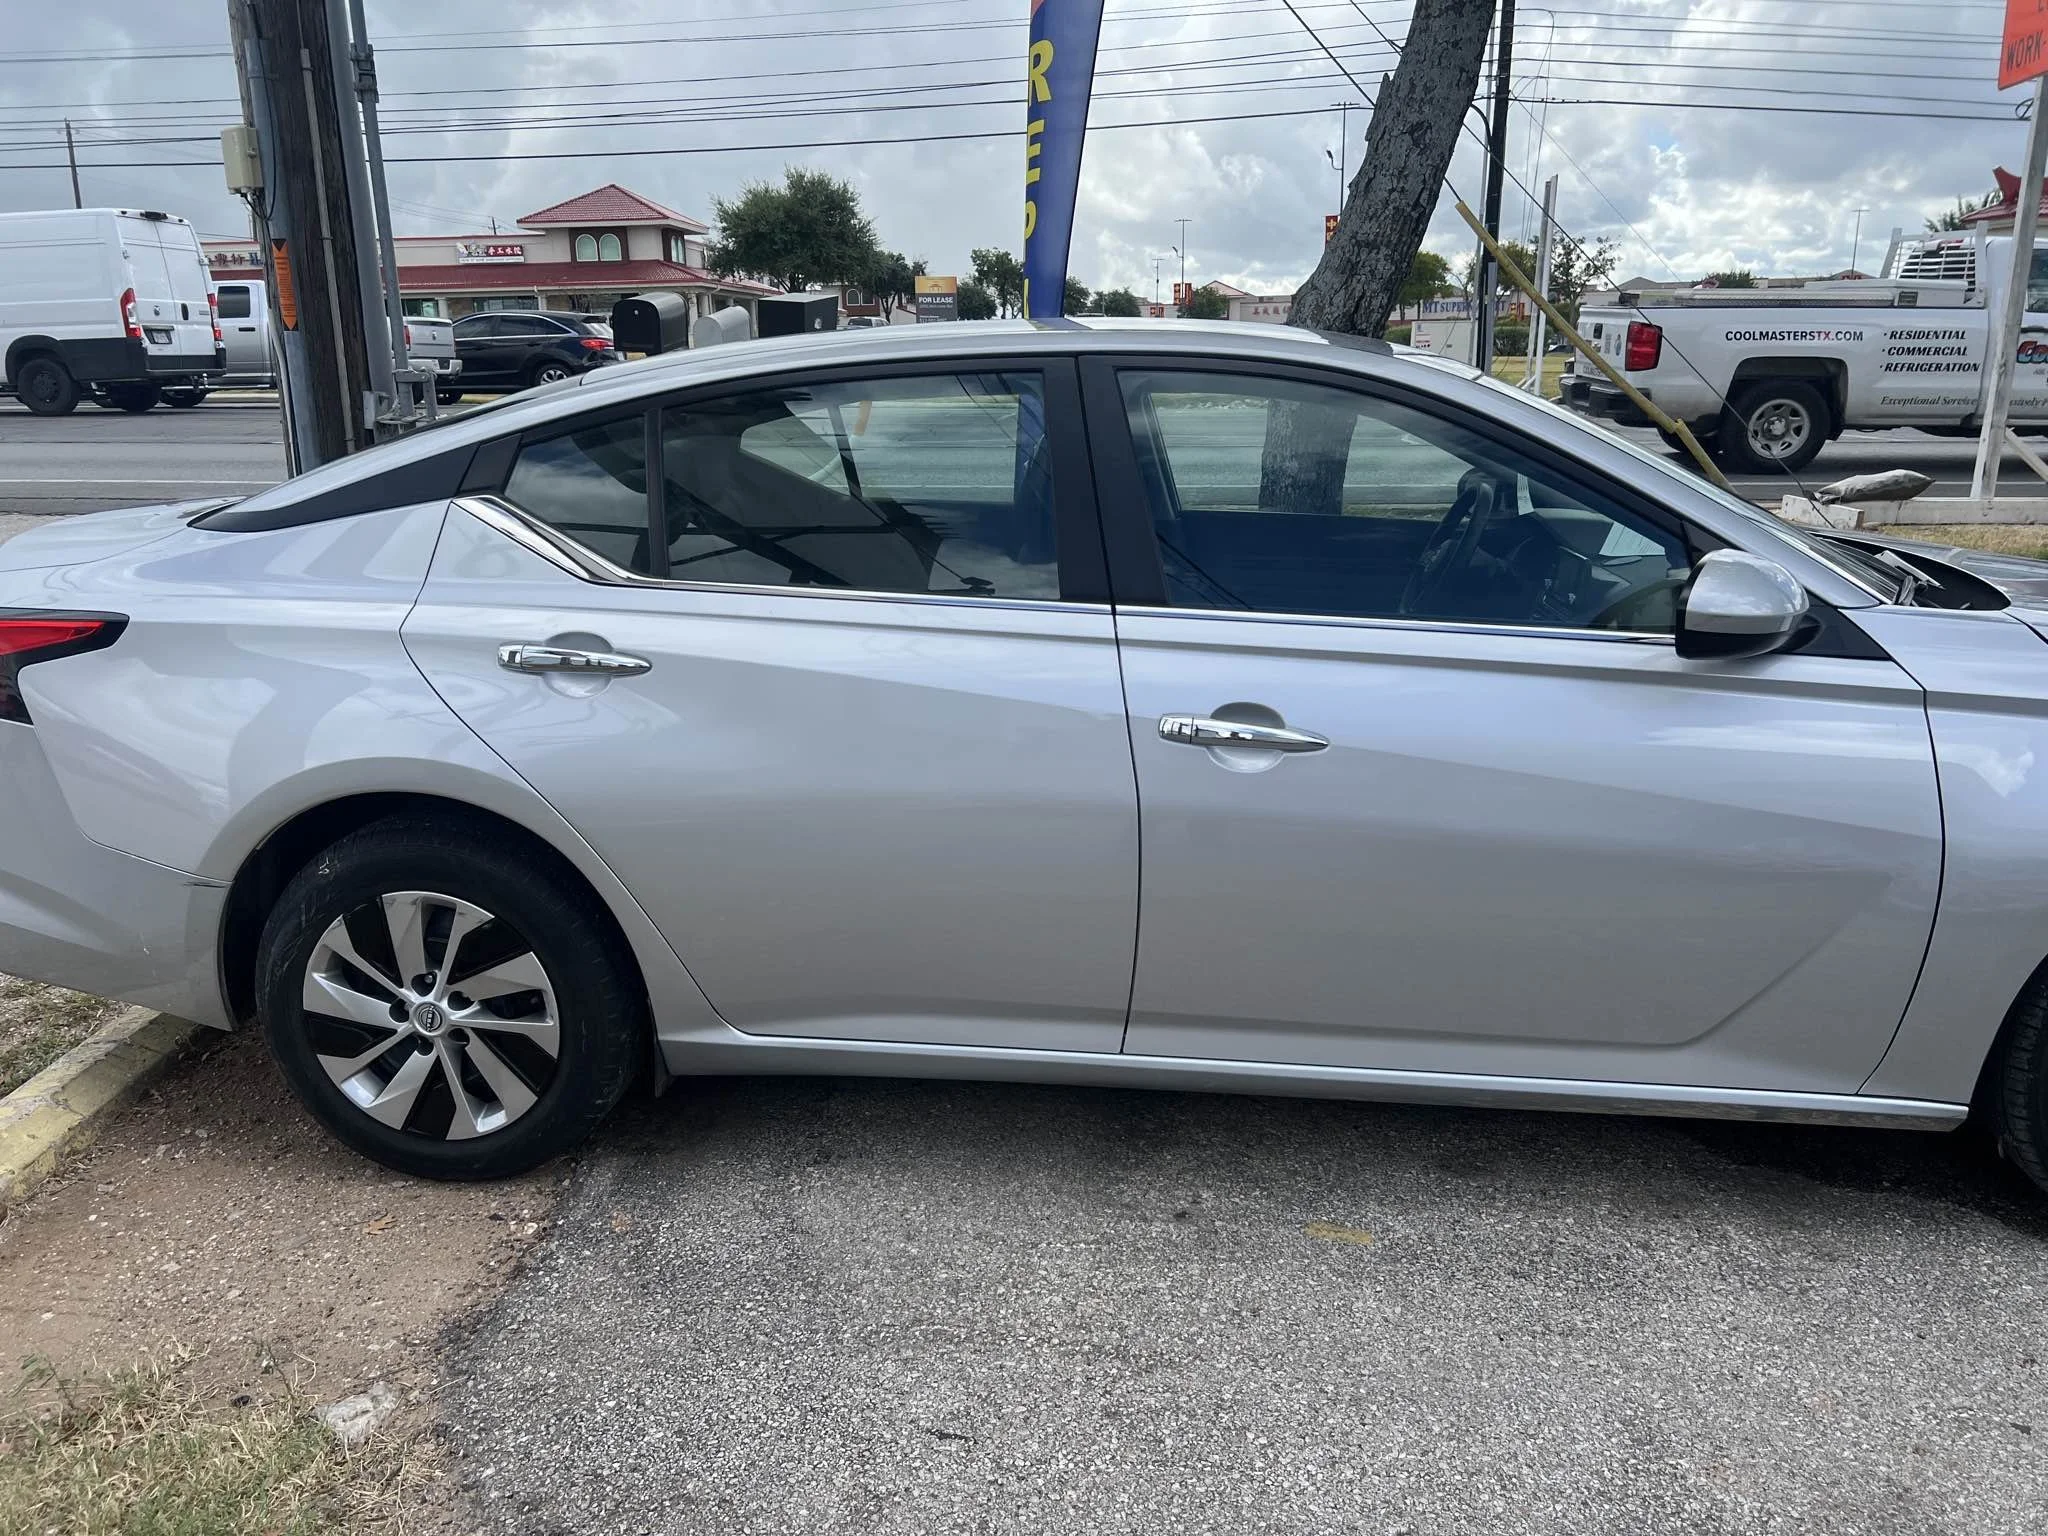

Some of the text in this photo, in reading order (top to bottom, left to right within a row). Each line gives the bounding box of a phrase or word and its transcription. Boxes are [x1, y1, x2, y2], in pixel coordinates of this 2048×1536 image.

[918, 296, 954, 304] FOR LEASE
[1422, 301, 1440, 314] MT
[1725, 330, 1864, 342] COOLMASTERSTX.COM
[1889, 330, 1967, 340] RESIDENTIAL
[1887, 346, 1968, 356] COMMERCIAL
[1884, 362, 1981, 373] REFRIGERATION
[1880, 395, 1941, 407] Exceptional
